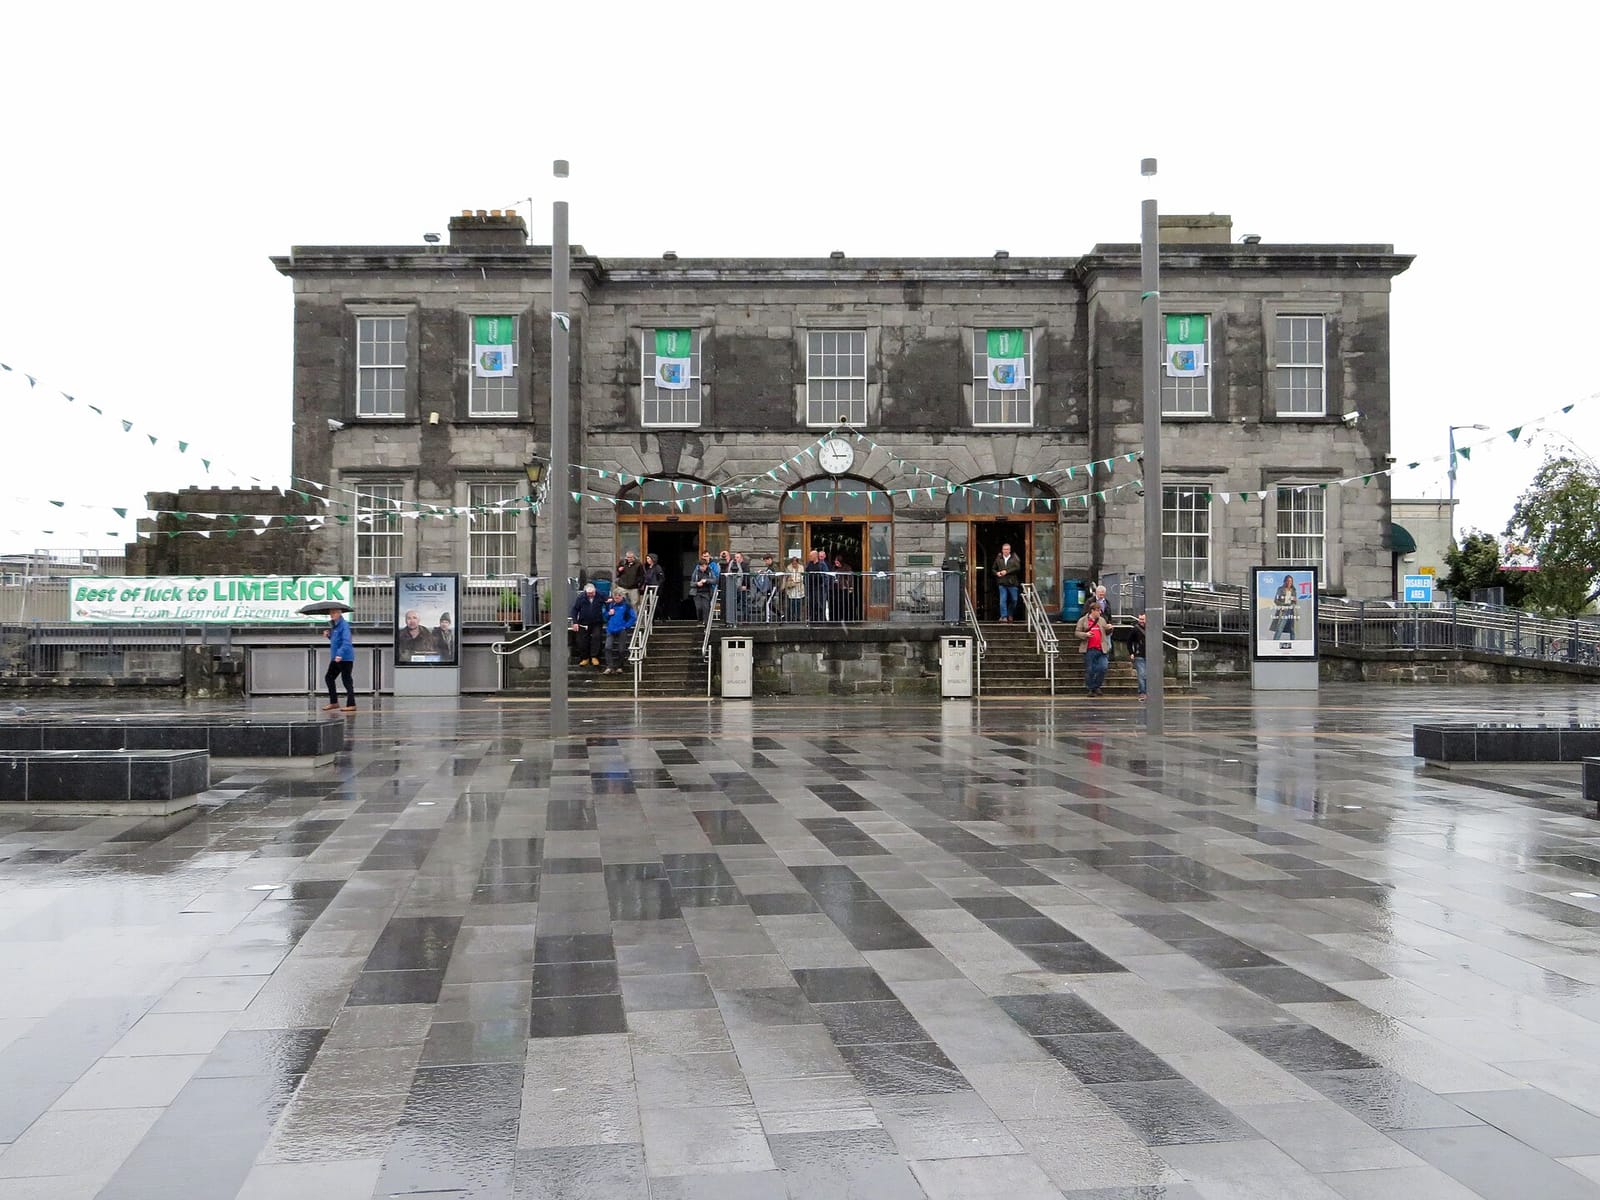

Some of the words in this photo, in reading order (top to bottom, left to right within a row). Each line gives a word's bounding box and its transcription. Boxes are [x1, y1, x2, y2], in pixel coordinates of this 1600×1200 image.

[75, 587, 117, 602] Best
[120, 587, 141, 602] of
[144, 587, 183, 602] luck
[187, 588, 209, 602] to
[214, 581, 345, 601] LIMERICK
[405, 582, 426, 592] Sick
[428, 582, 439, 592] of
[439, 582, 447, 592] it
[131, 606, 170, 619] From
